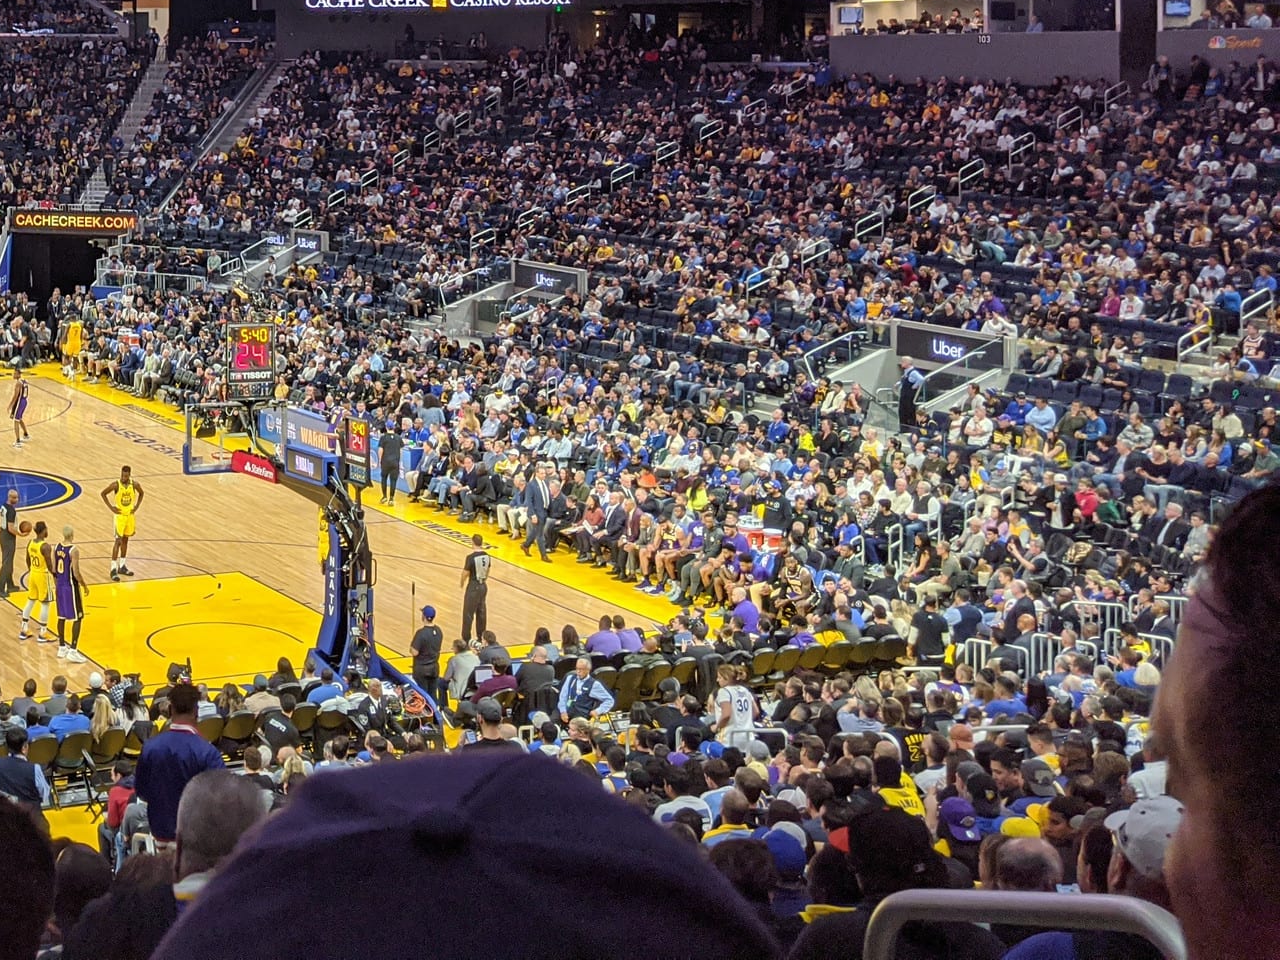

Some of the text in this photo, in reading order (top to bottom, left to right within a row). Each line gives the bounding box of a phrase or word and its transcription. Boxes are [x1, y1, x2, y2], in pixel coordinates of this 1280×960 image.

[978, 35, 991, 44] 103
[15, 214, 135, 229] CACHECREEK.COM
[297, 238, 317, 250] Uber
[241, 328, 268, 343] 5:40
[933, 338, 963, 358] Uber
[236, 344, 265, 369] 24
[243, 371, 272, 380] TISSOT
[735, 697, 750, 713] 30
